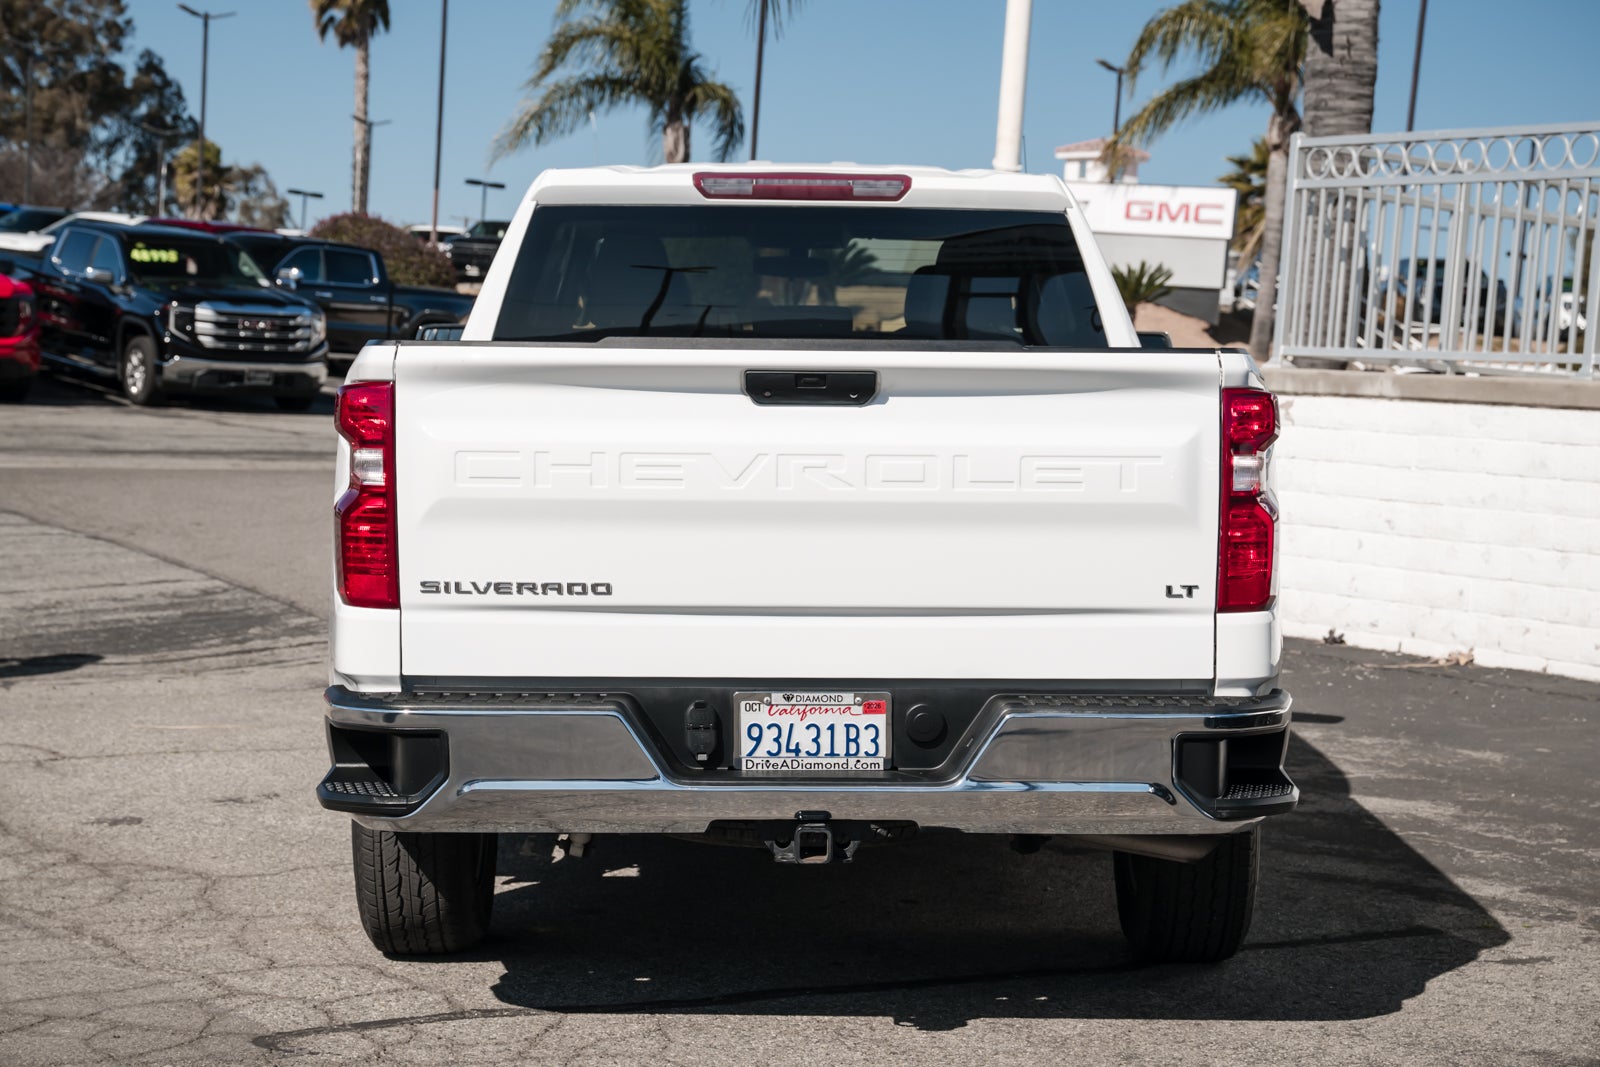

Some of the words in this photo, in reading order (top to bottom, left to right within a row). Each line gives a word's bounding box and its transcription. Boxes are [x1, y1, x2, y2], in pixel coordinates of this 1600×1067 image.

[1126, 200, 1224, 224] GMC
[453, 450, 1163, 493] CHEVROLET
[420, 581, 612, 596] SILVERADO
[1166, 585, 1199, 599] LT
[796, 694, 843, 703] DIAMOND
[745, 703, 761, 712] OCT
[768, 704, 862, 721] California
[746, 723, 879, 757] 93431B3
